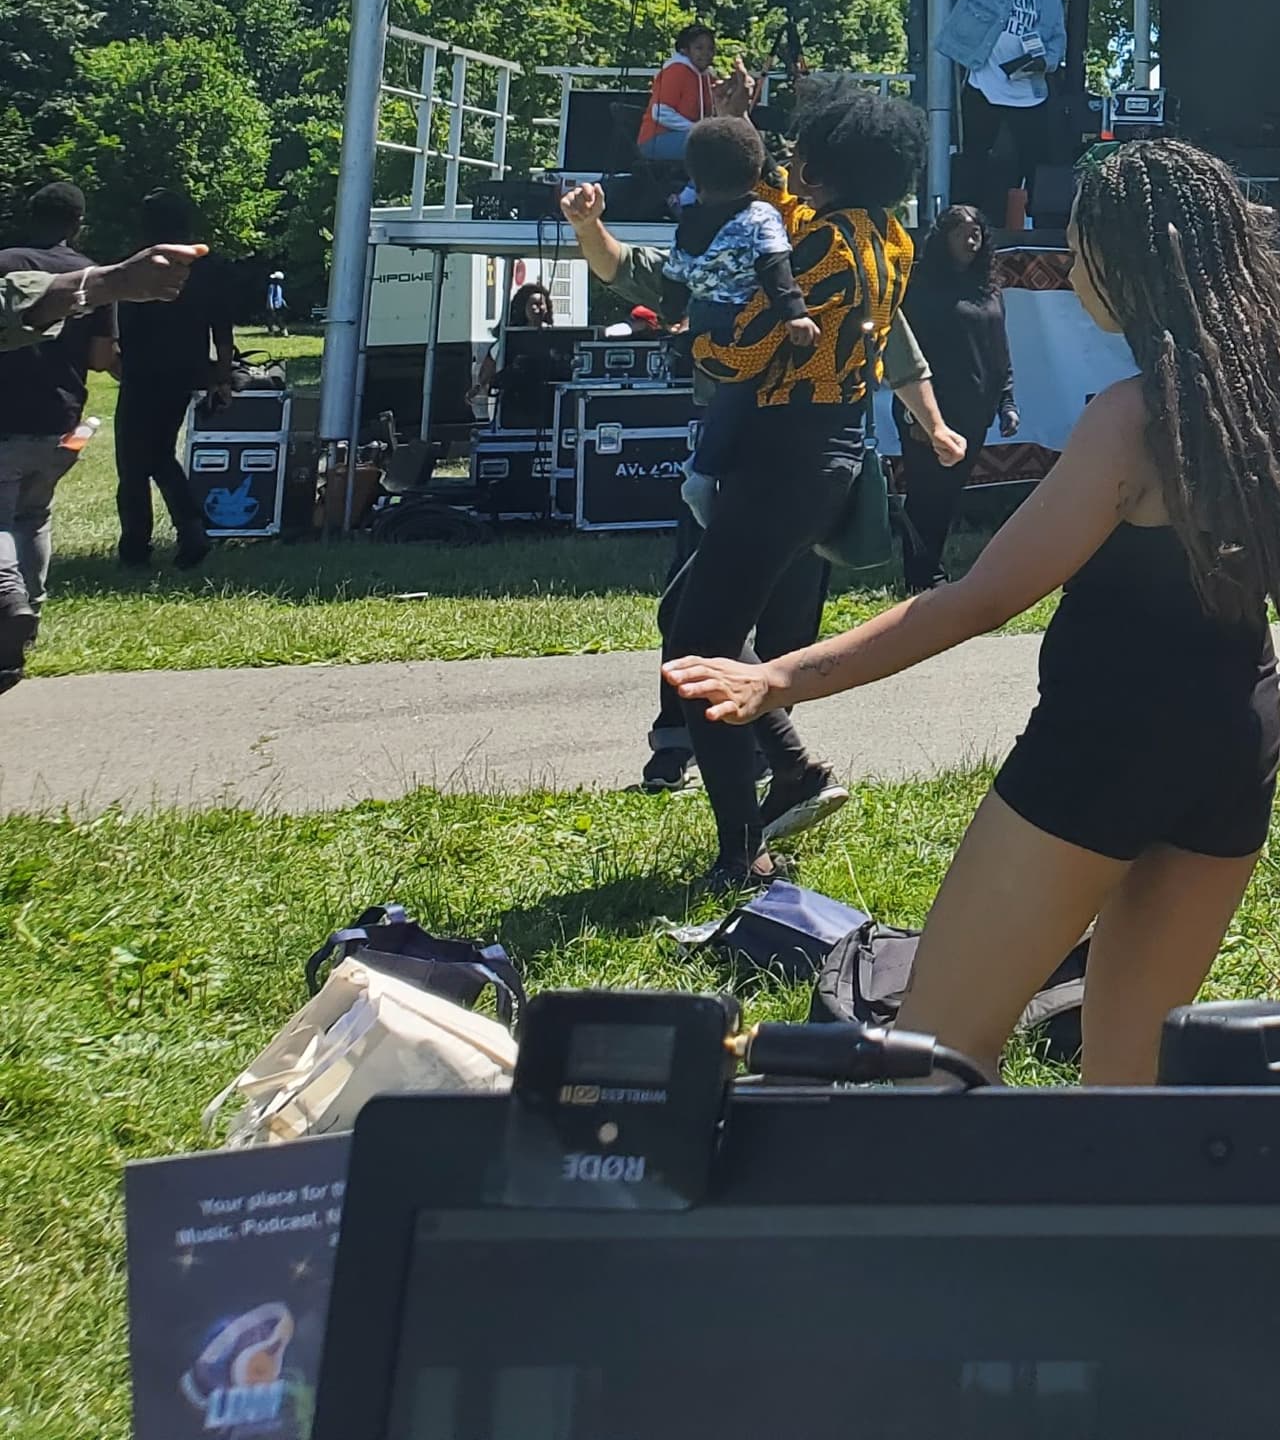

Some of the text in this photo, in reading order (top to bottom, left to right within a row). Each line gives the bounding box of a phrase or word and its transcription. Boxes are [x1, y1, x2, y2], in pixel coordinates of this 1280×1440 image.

[200, 1196, 243, 1216] Your
[247, 1189, 298, 1211] place
[301, 1184, 328, 1201] for
